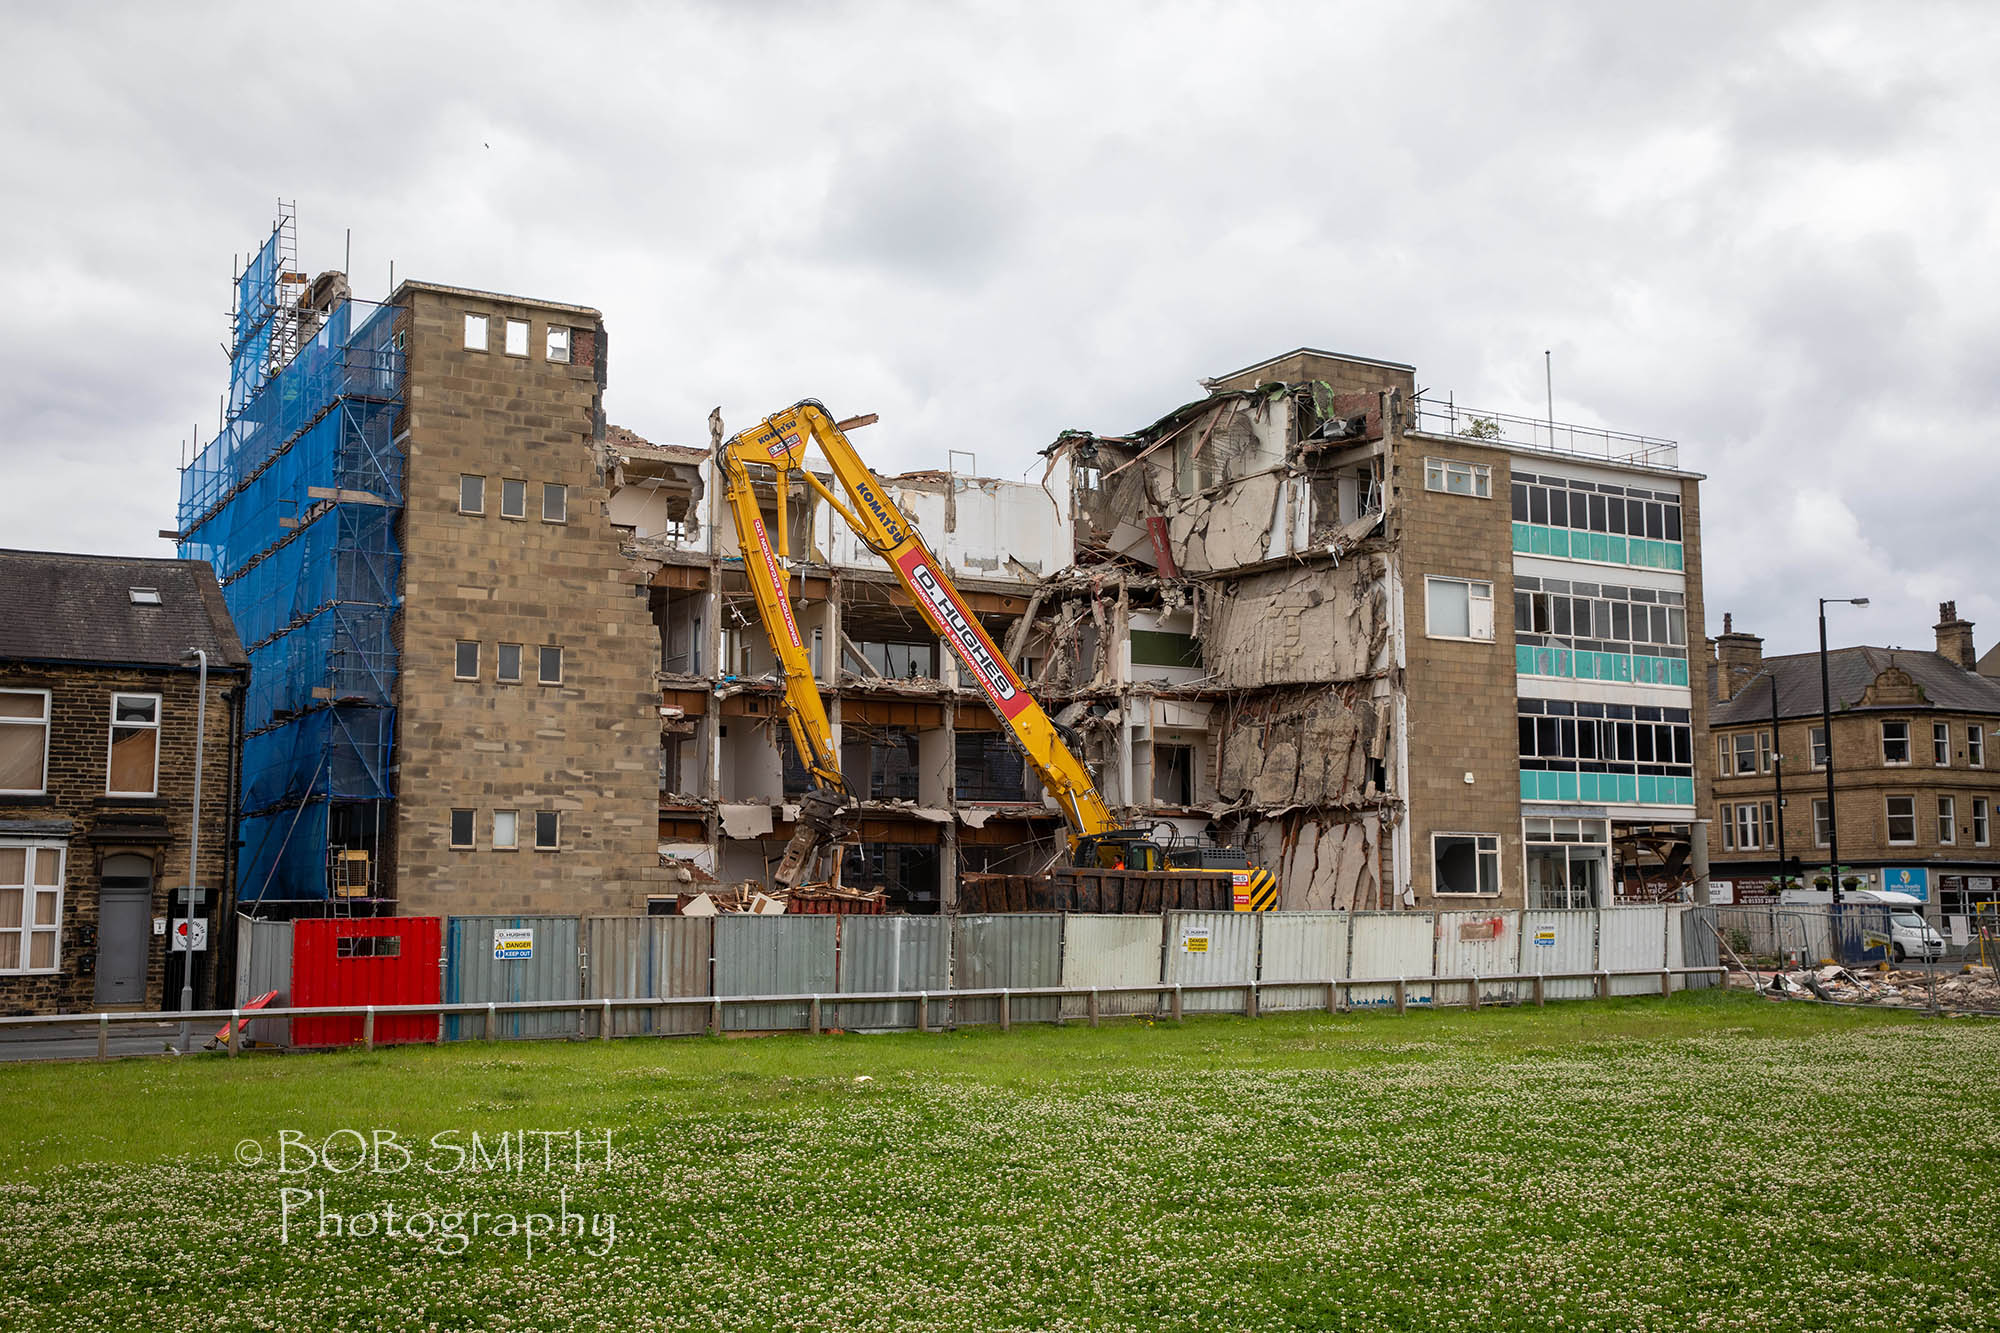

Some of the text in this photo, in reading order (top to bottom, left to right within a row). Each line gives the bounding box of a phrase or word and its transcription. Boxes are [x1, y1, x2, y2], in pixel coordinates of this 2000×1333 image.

[757, 420, 797, 445] KOMATSU
[776, 435, 798, 449] HUHES
[856, 482, 903, 543] KOMATSU
[760, 538, 780, 588] EXCAVATION
[780, 598, 800, 647] DEMOLITION
[911, 578, 946, 624] DEMOLITION
[951, 634, 988, 683] EXCAVATION
[987, 681, 999, 699] LTD.
[918, 570, 1010, 694] D. HUGHES
